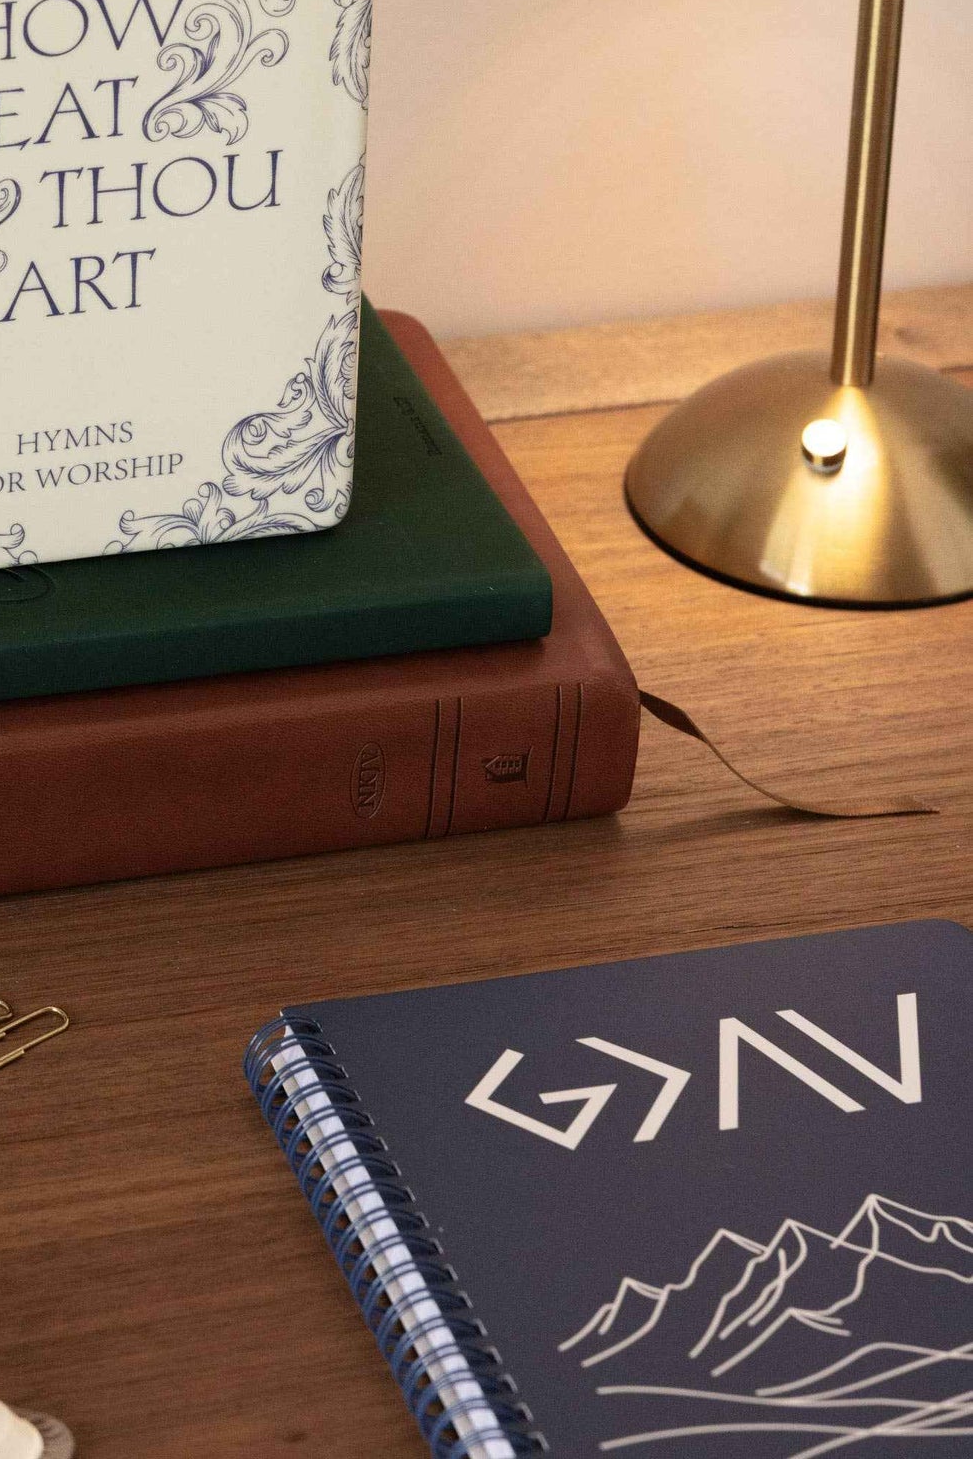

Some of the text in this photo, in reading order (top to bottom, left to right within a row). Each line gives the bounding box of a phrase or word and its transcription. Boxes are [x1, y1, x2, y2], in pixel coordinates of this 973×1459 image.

[39, 149, 284, 229] THOU
[16, 420, 134, 455] HYMNS
[35, 452, 184, 489] WORSHIP
